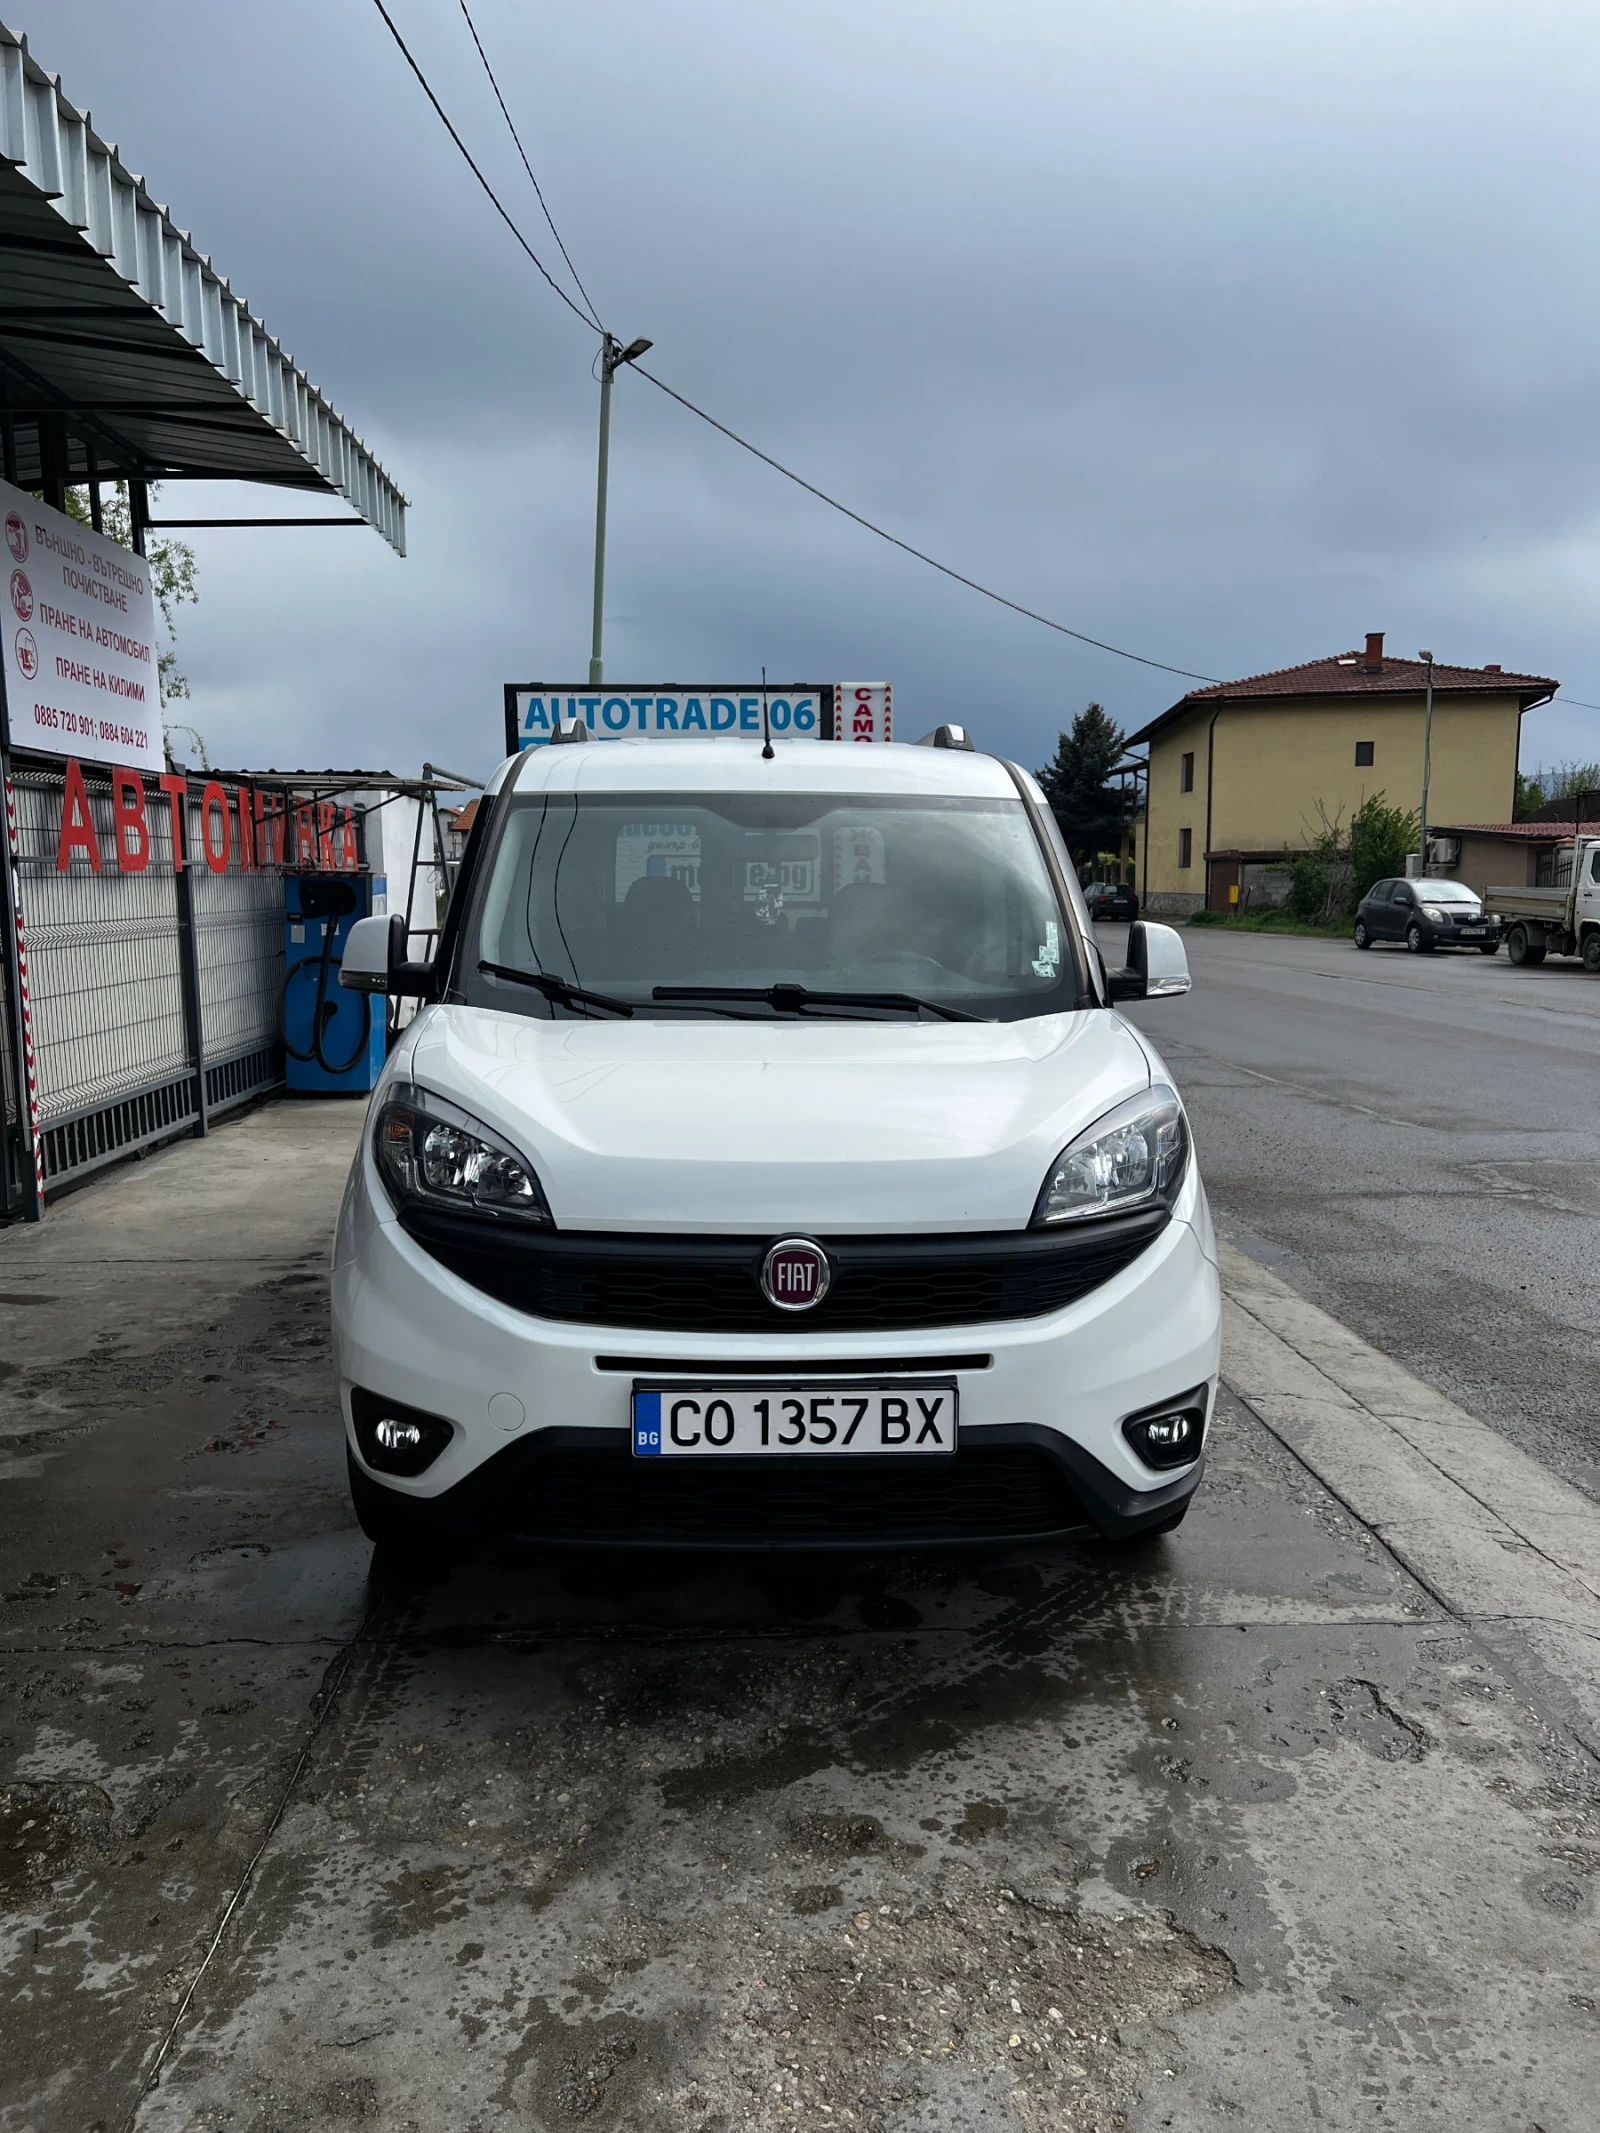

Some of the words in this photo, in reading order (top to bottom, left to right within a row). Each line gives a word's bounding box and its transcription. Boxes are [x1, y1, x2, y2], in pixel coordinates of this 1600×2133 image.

[35, 524, 85, 566] ВЪНШНО
[92, 553, 144, 596] ВЪТРЕШНО
[62, 565, 128, 613] ПОЧИСТВАНЕ
[39, 603, 77, 636] ПРАНЕ
[78, 618, 94, 642] НА
[95, 625, 151, 664] АВТОМОБИЛ
[56, 656, 92, 686] ПРАНЕ
[92, 668, 108, 691] НА
[108, 673, 146, 703] КИЛИМИ
[34, 703, 59, 729] 0885
[60, 710, 78, 733] 720
[79, 715, 98, 741] 901;
[99, 721, 119, 742] 0884
[120, 726, 134, 746] 604
[135, 729, 149, 749] 221
[524, 697, 760, 731] AUTOTRADE
[769, 699, 816, 731] 06
[777, 1262, 816, 1292] FIAT
[637, 1431, 659, 1446] BG
[670, 1398, 735, 1447] CO
[753, 1397, 869, 1446] 1357
[880, 1397, 945, 1445] BX
